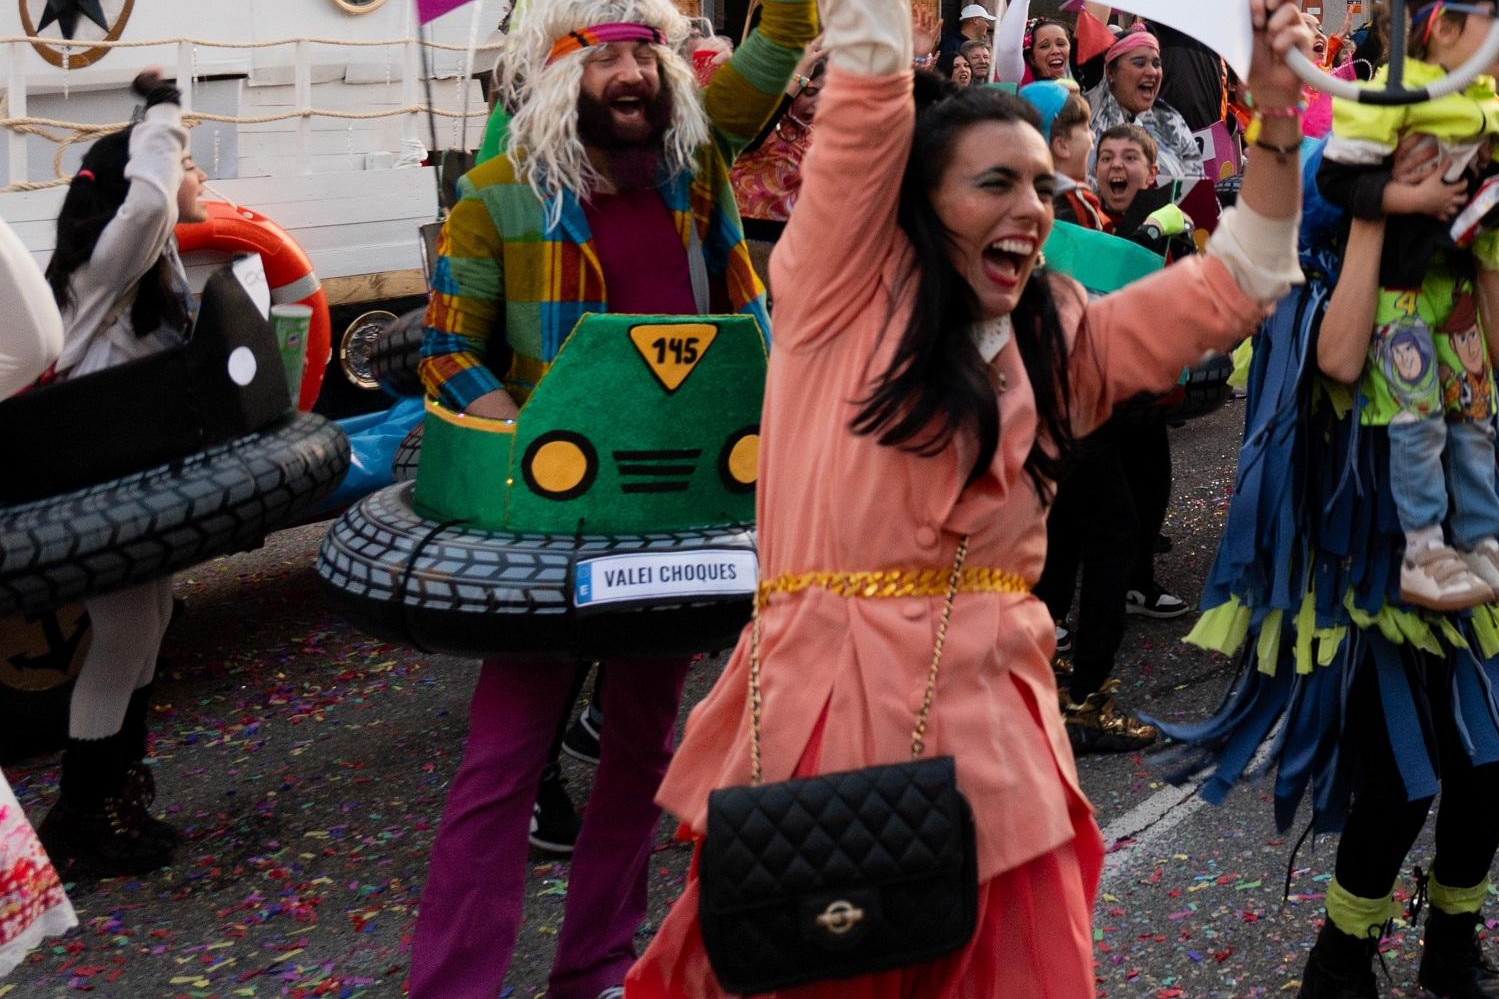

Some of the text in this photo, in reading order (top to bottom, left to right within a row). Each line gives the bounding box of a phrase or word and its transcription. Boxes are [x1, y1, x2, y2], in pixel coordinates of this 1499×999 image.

[652, 337, 700, 364] 145
[605, 563, 737, 587] VALEI CHOQUES
[579, 584, 588, 596] E
